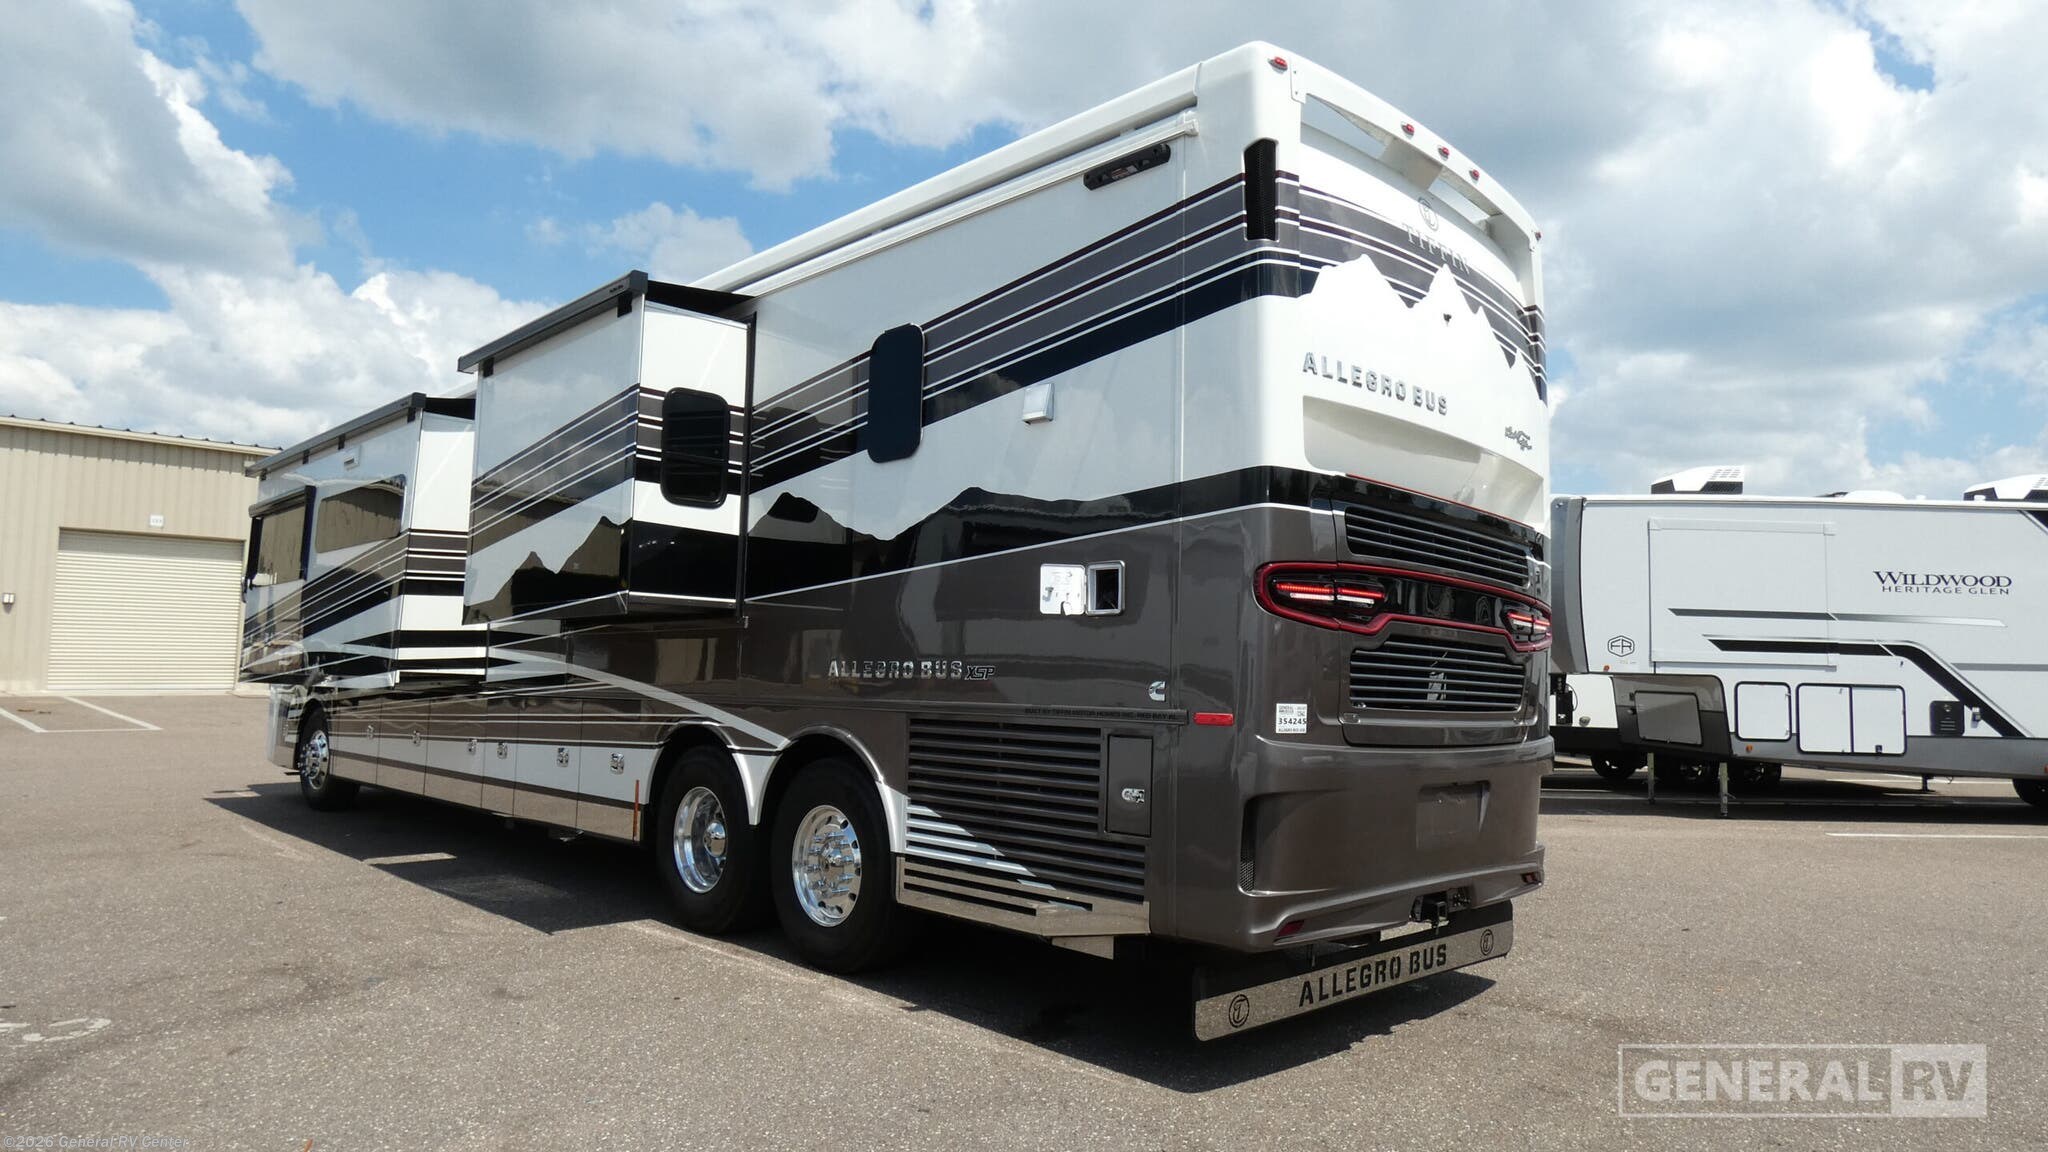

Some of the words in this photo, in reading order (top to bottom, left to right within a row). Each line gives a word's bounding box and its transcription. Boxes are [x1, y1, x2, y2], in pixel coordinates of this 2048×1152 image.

[1302, 351, 1407, 402] ALLEGRO
[1412, 385, 1448, 416] BUS
[1882, 585, 1963, 595] HERITAGE
[1968, 586, 2010, 595] GLEN
[828, 660, 914, 679] ALLEGRO
[920, 660, 963, 679] BUS
[964, 665, 996, 681] XSP
[1278, 717, 1307, 725] 354245
[1299, 954, 1401, 1008] ALLEGRO
[1409, 944, 1447, 976] BUS
